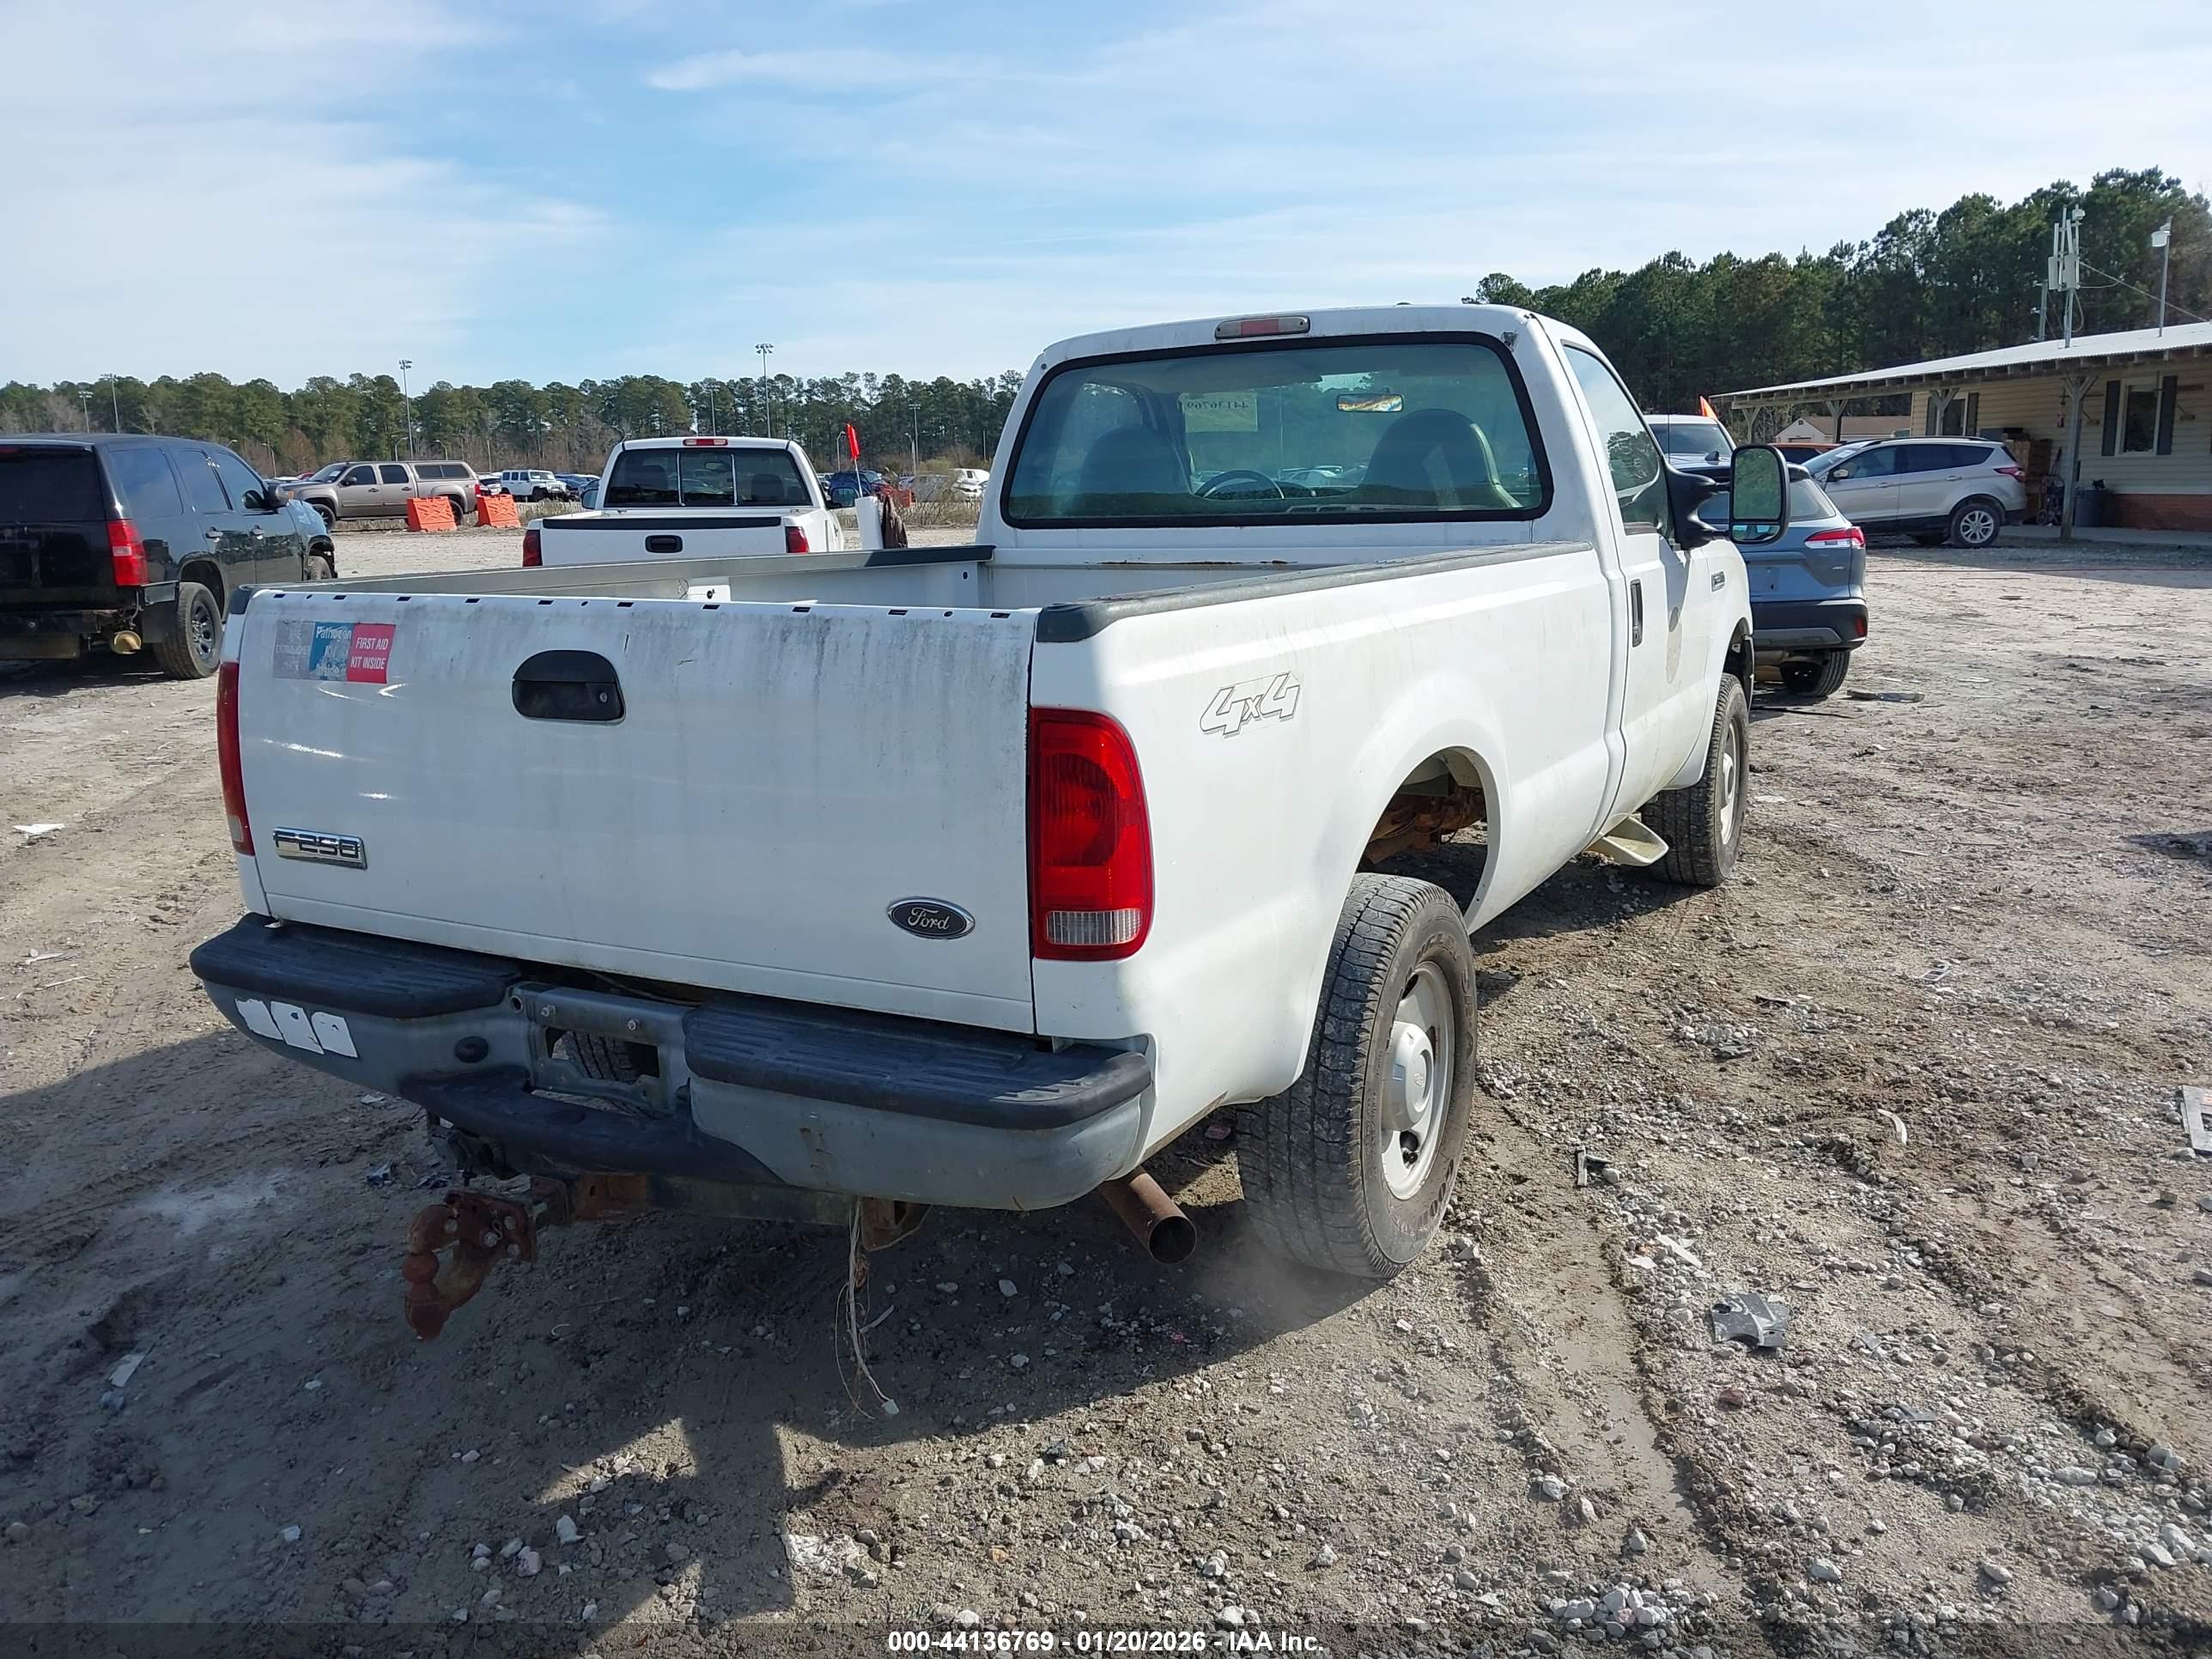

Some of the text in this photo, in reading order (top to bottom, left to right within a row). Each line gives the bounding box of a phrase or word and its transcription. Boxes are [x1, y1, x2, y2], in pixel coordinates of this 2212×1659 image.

[315, 626, 351, 642] Pathogen
[356, 637, 389, 651] FIRST AID
[350, 656, 386, 670] KIT INSIDE
[908, 907, 950, 930] Ford
